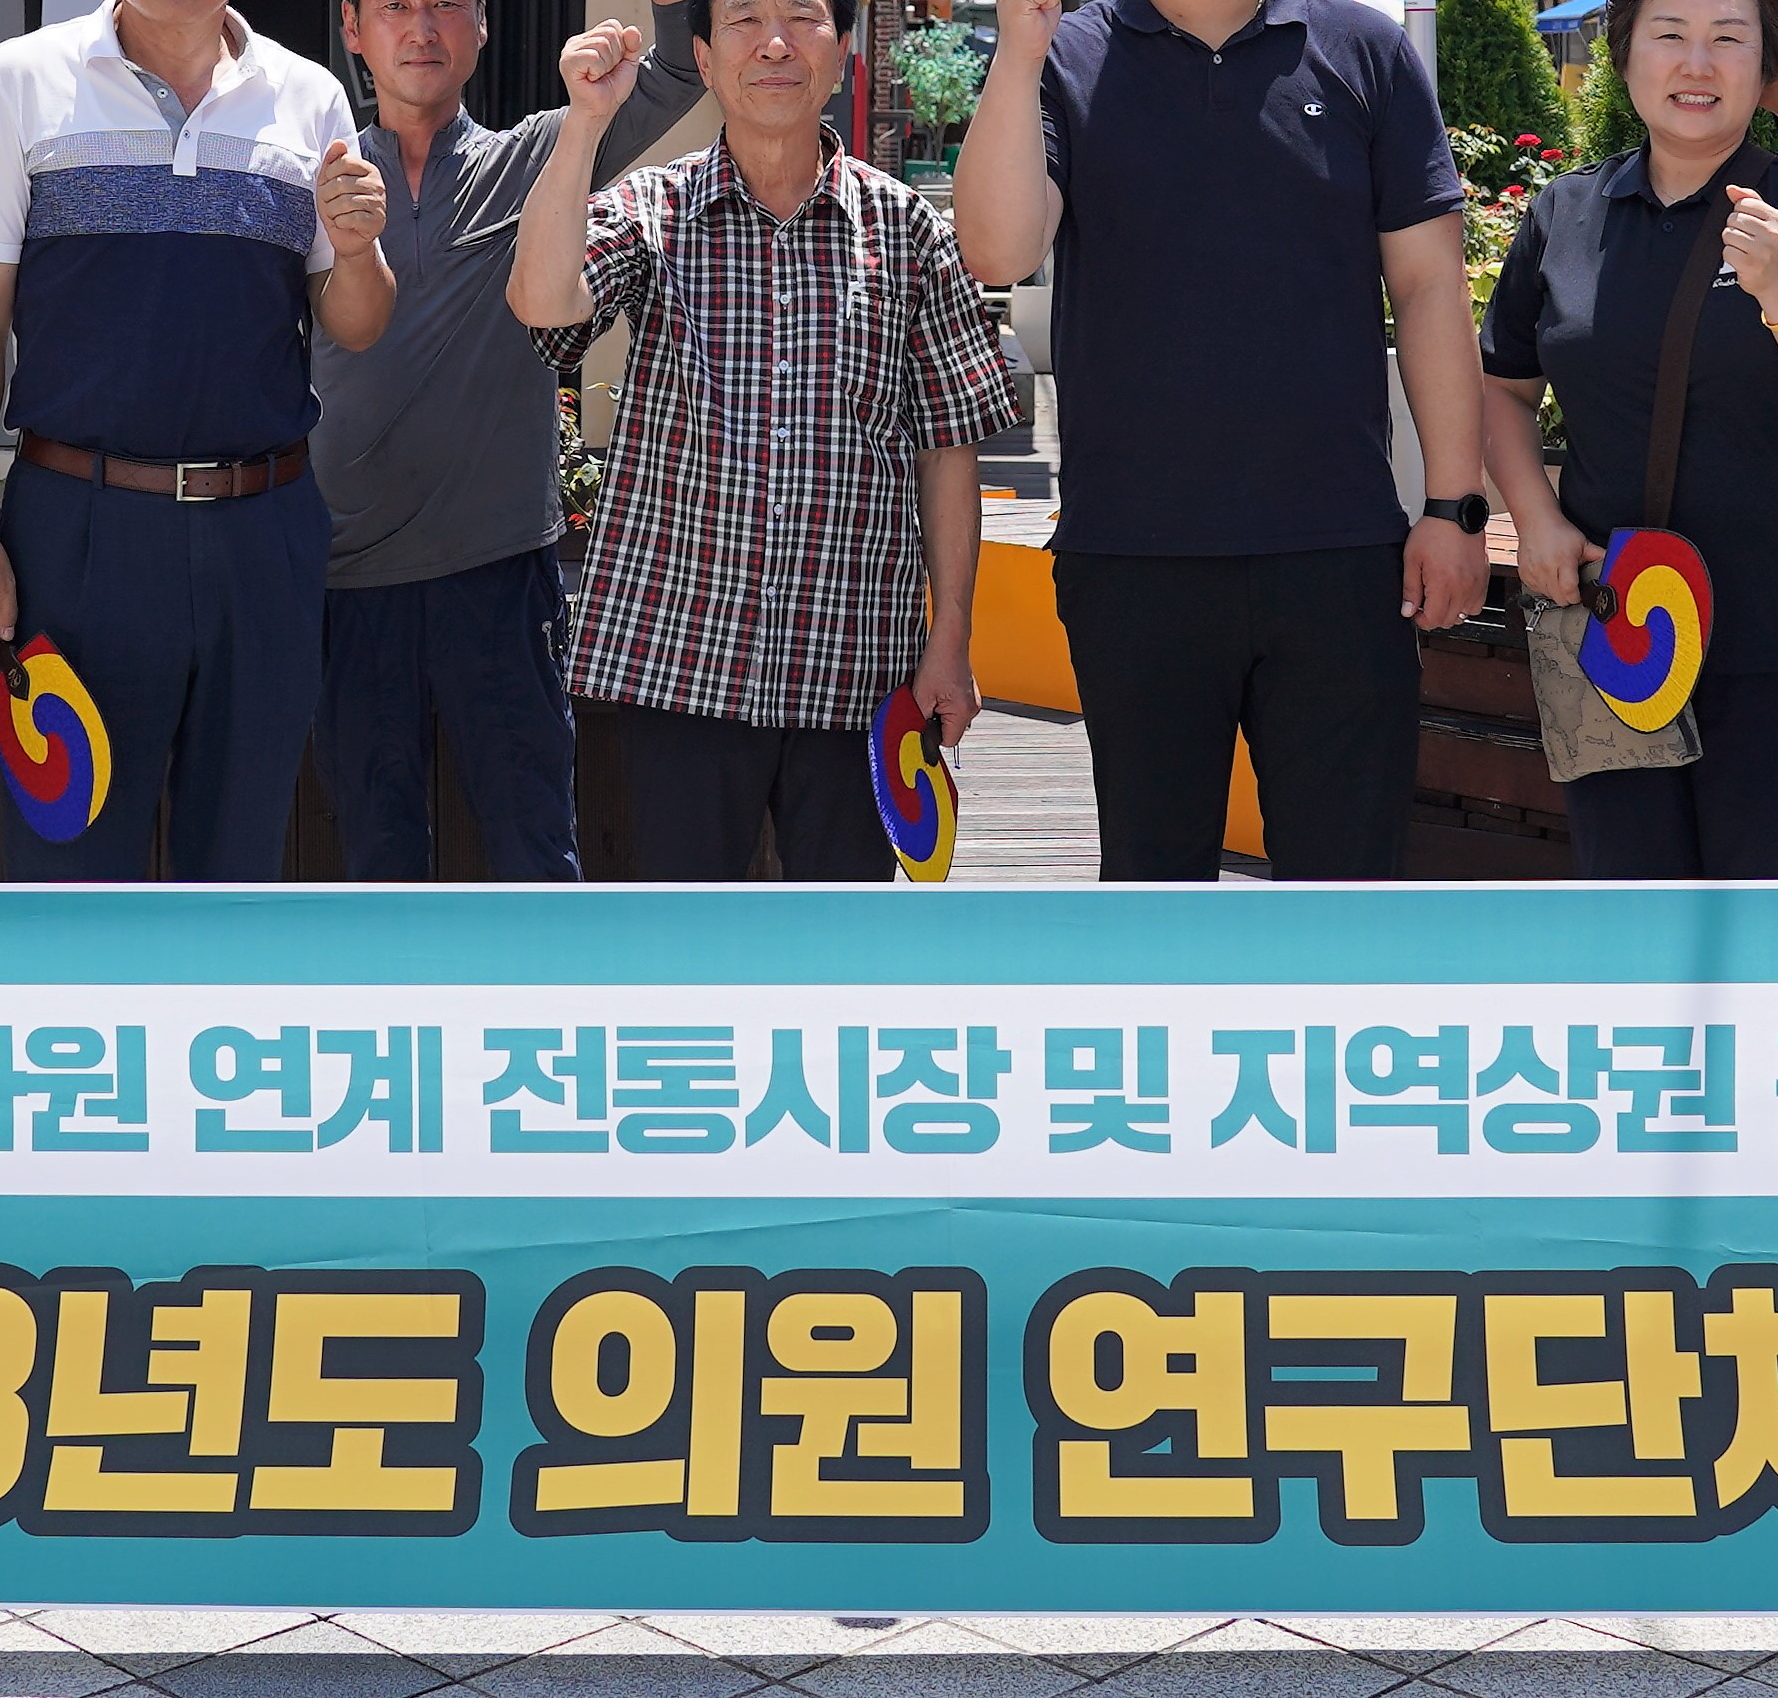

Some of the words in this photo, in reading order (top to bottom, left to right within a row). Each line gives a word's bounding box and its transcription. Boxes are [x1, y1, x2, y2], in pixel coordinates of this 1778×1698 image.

[188, 1024, 444, 1155] 연계
[482, 1024, 1011, 1156] 전통시장
[1044, 1024, 1173, 1156] 및
[1210, 1024, 1738, 1155] 지역상권
[530, 1285, 969, 1522] 의원
